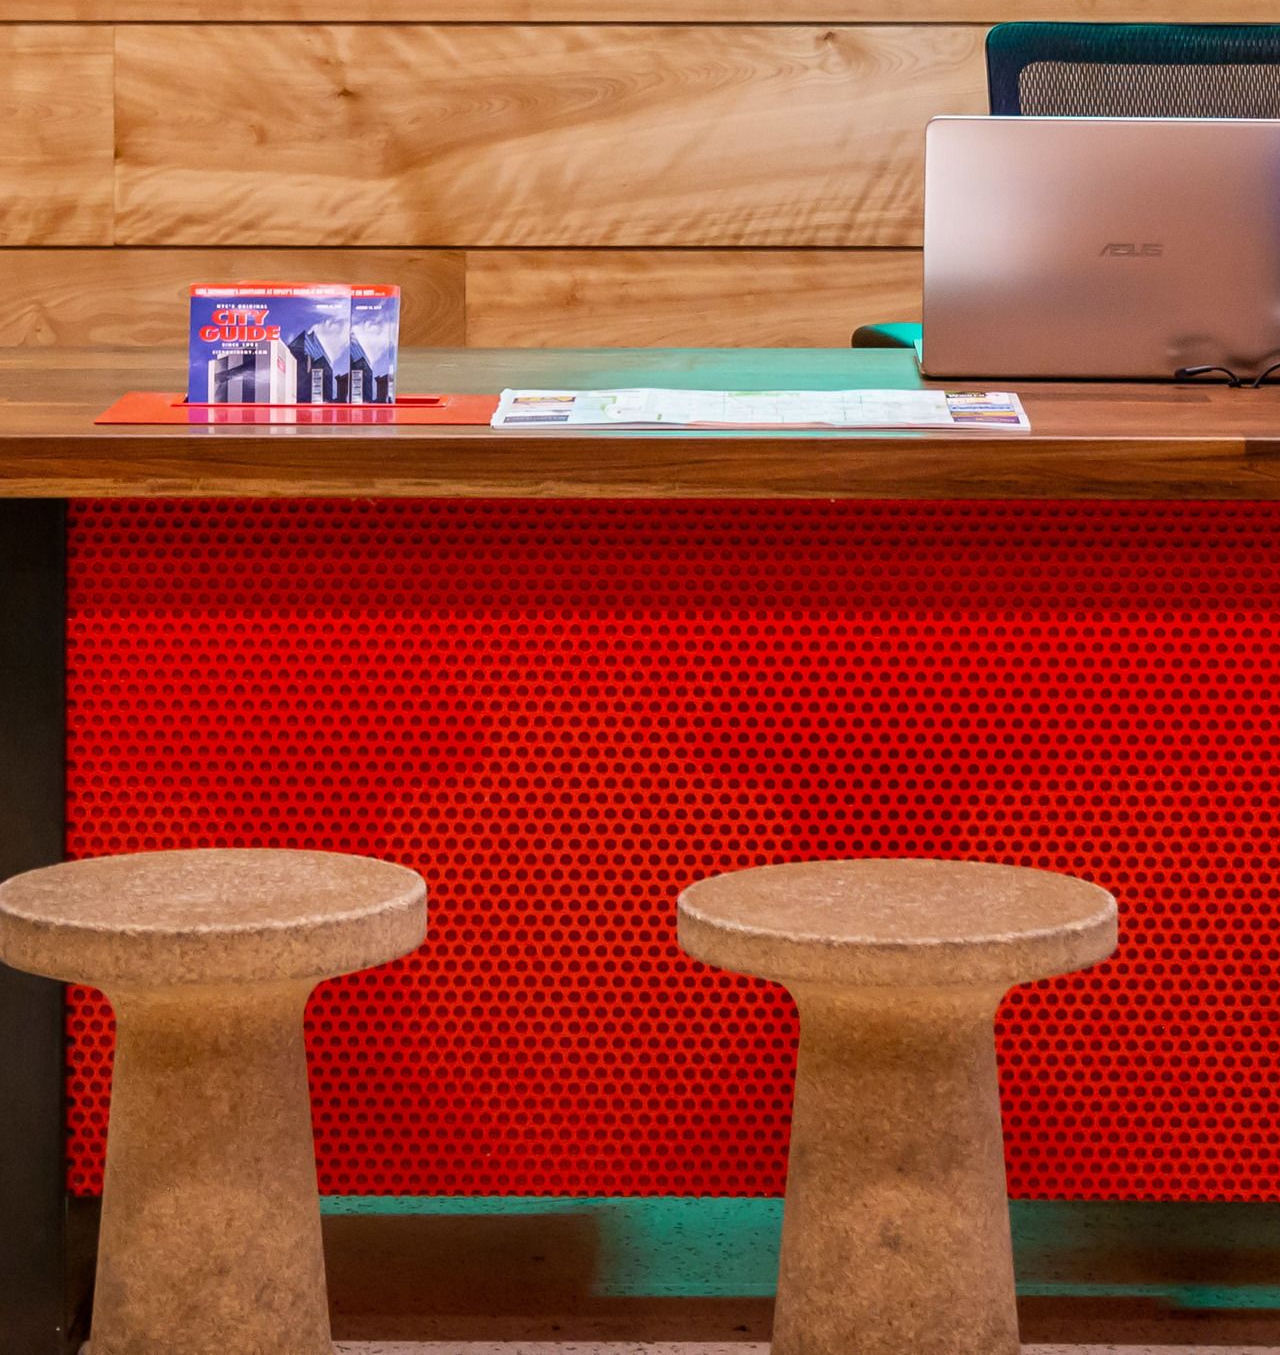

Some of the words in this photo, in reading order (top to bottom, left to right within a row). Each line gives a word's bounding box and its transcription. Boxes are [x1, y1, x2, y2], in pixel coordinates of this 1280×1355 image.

[1099, 243, 1163, 257] ASUS
[211, 309, 270, 326] CITY
[198, 325, 281, 342] GUIDE
